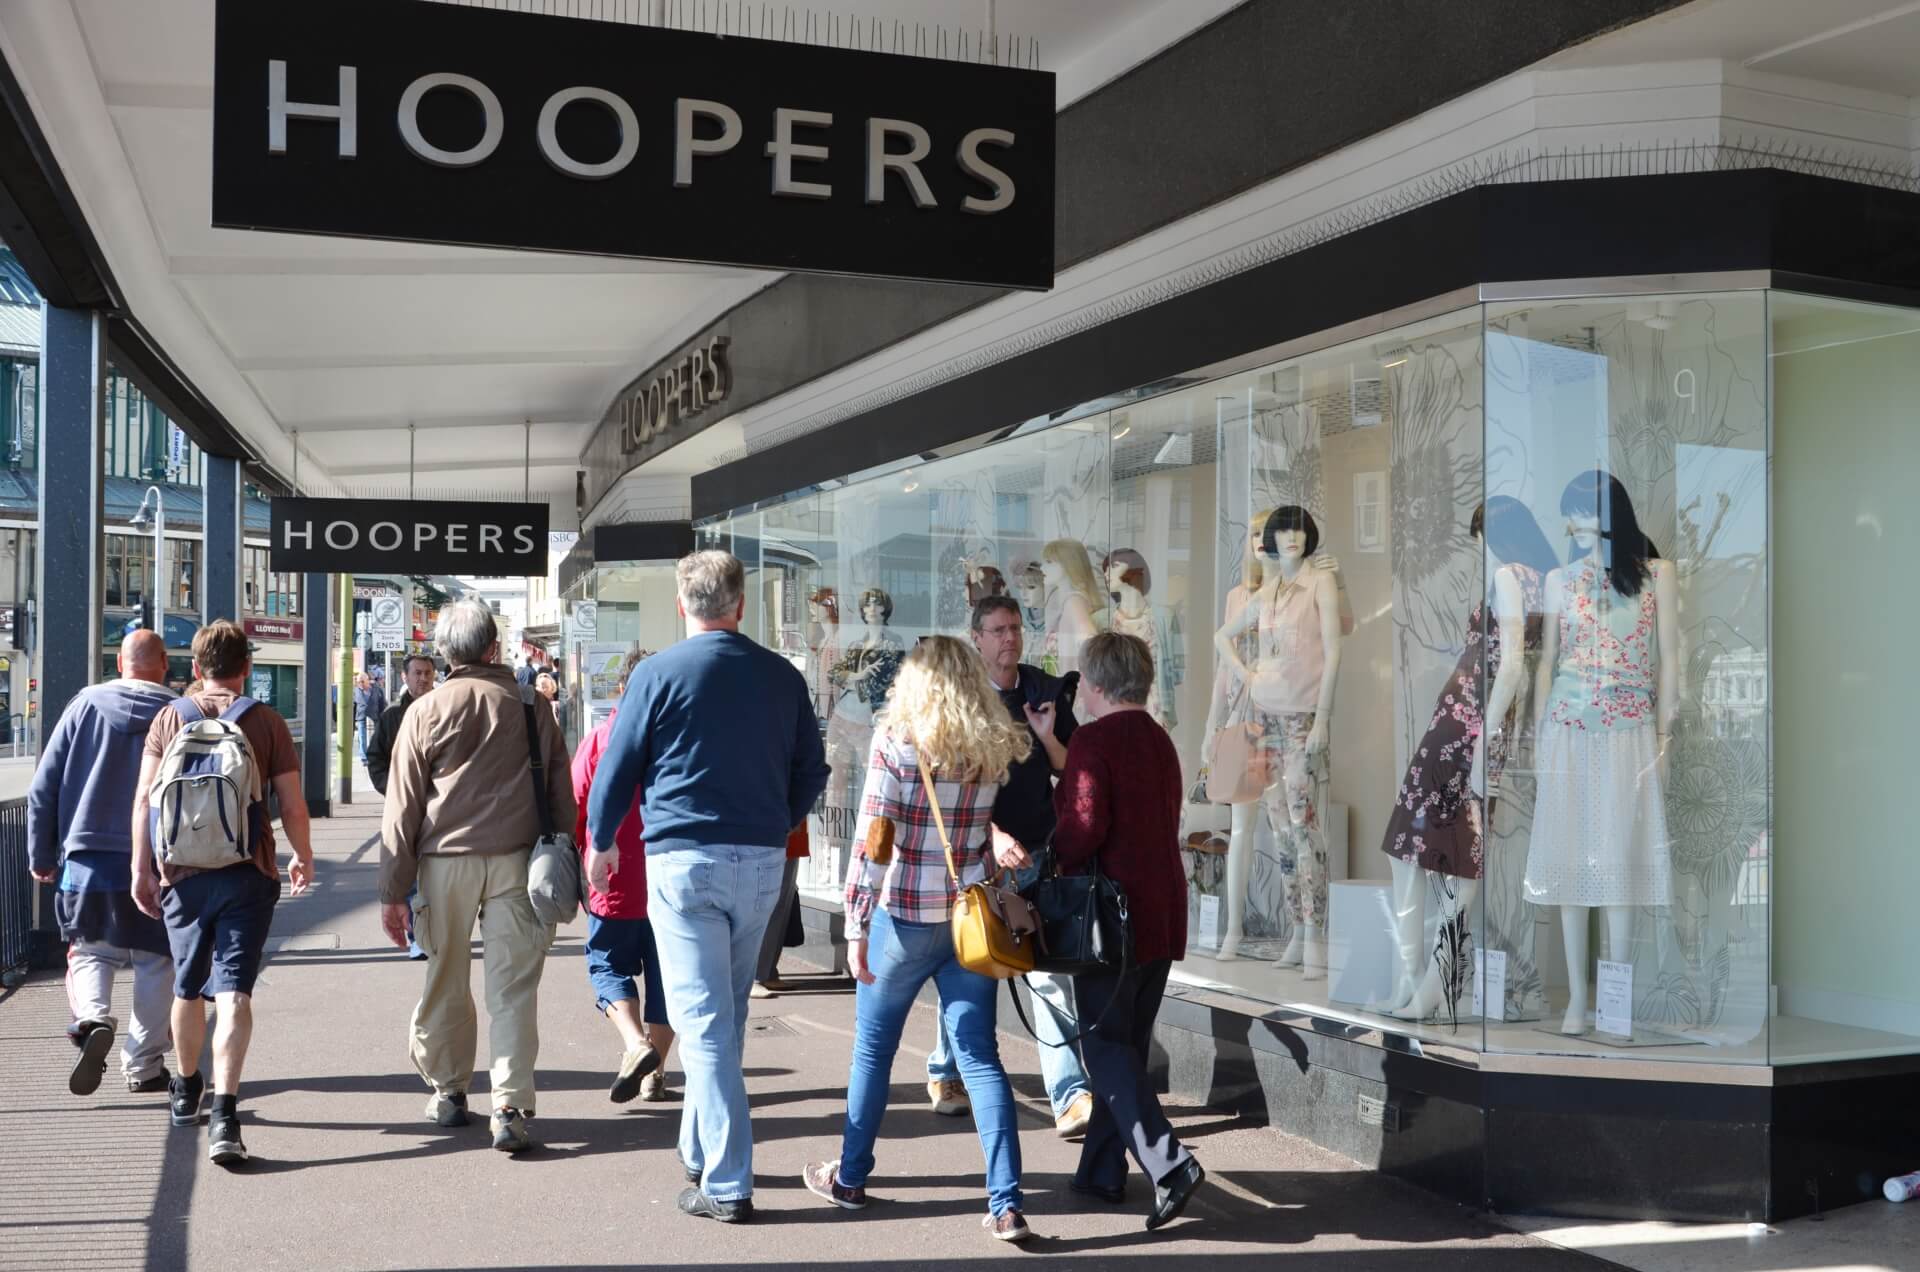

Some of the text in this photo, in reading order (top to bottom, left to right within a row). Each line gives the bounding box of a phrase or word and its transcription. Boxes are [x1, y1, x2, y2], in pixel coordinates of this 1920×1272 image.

[267, 59, 1016, 215] HOOPERS
[620, 336, 732, 454] HOOPERS
[284, 520, 535, 554] HOOPERS
[255, 624, 279, 634] LLOYDS
